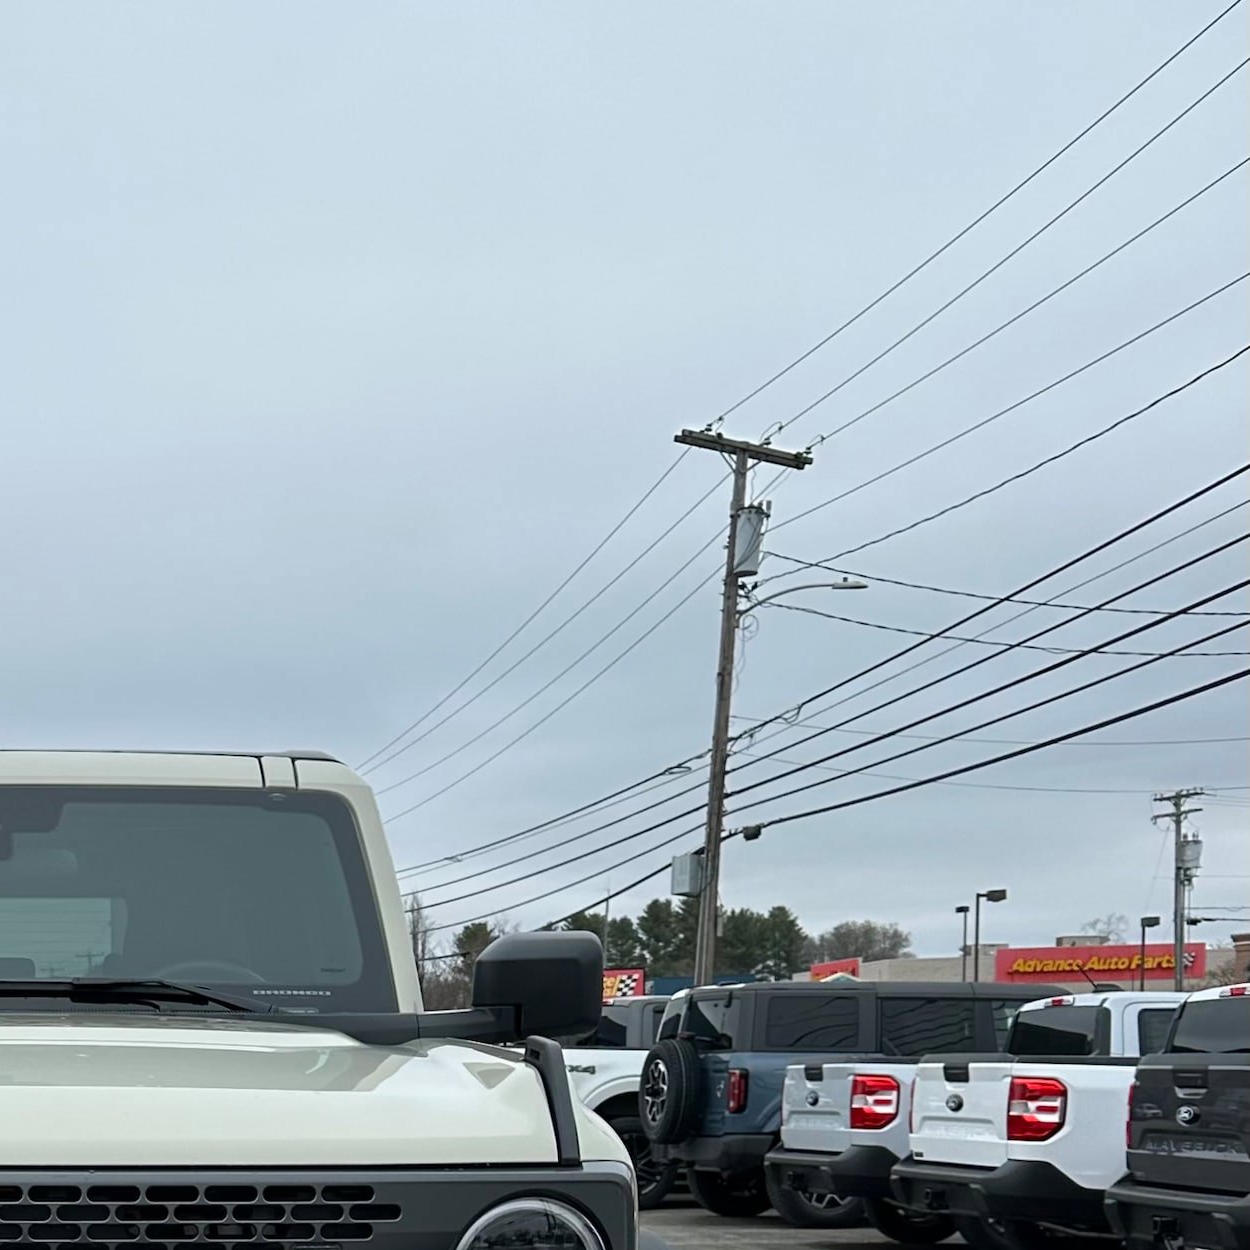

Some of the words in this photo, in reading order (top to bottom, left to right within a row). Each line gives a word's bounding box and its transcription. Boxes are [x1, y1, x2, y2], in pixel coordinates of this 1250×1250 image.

[1012, 957, 1081, 973] Advance
[1083, 956, 1129, 971] Auto
[1130, 954, 1175, 969] Parts
